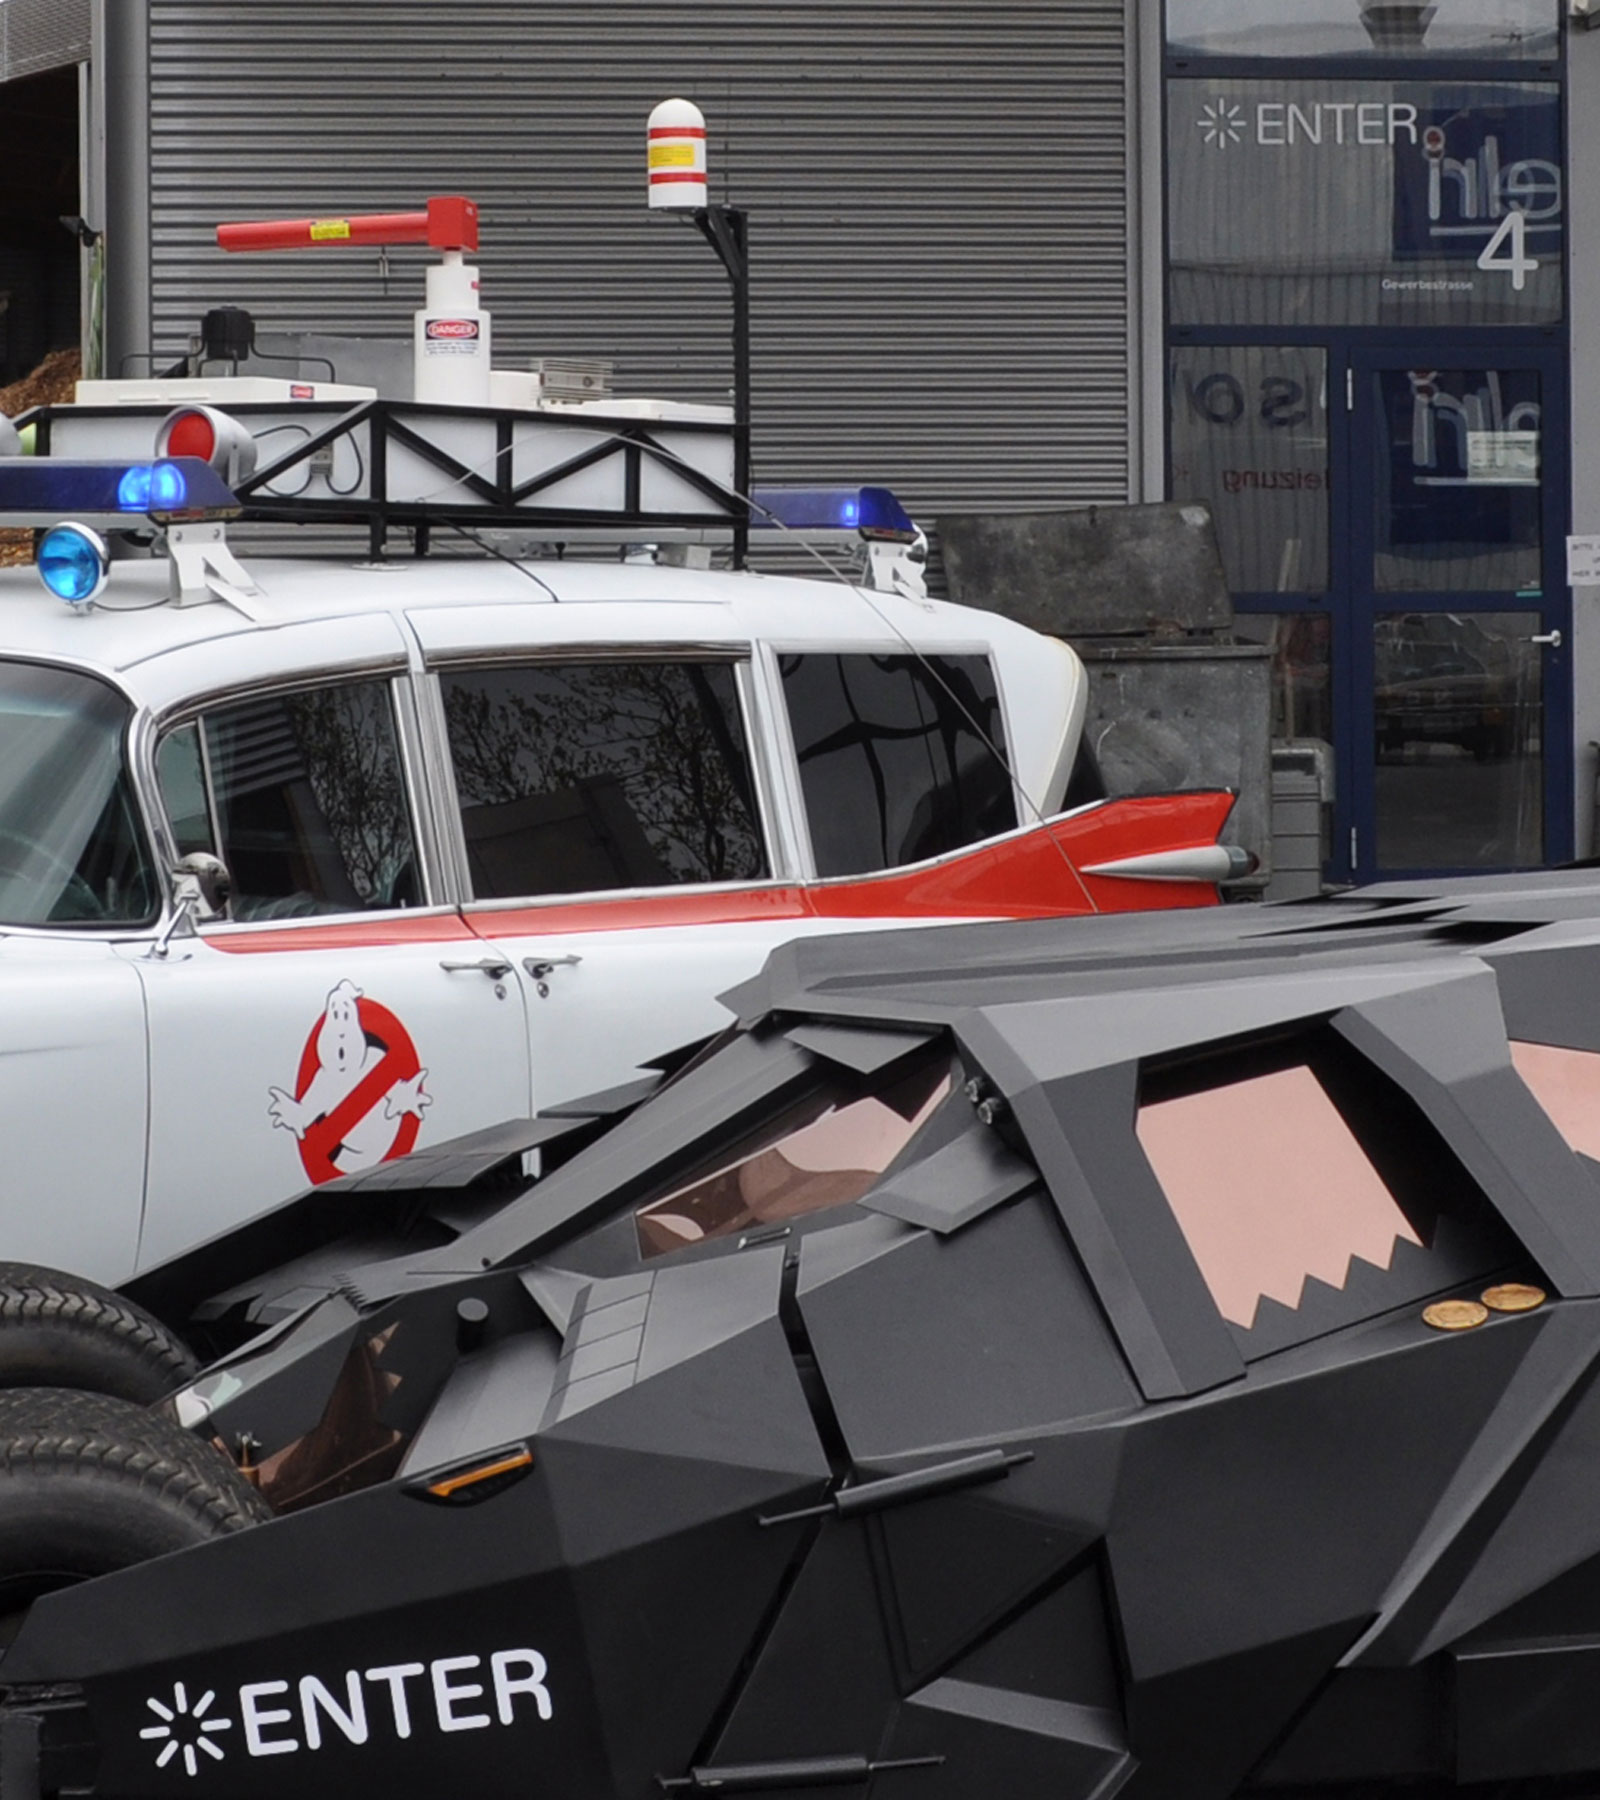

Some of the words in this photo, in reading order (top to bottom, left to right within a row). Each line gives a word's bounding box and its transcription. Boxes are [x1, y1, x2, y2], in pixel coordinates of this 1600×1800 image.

[1257, 103, 1417, 145] ENTER
[1381, 279, 1474, 290] Gewerbestrasse
[1476, 211, 1539, 291] 4
[239, 1648, 553, 1757] ENTER
